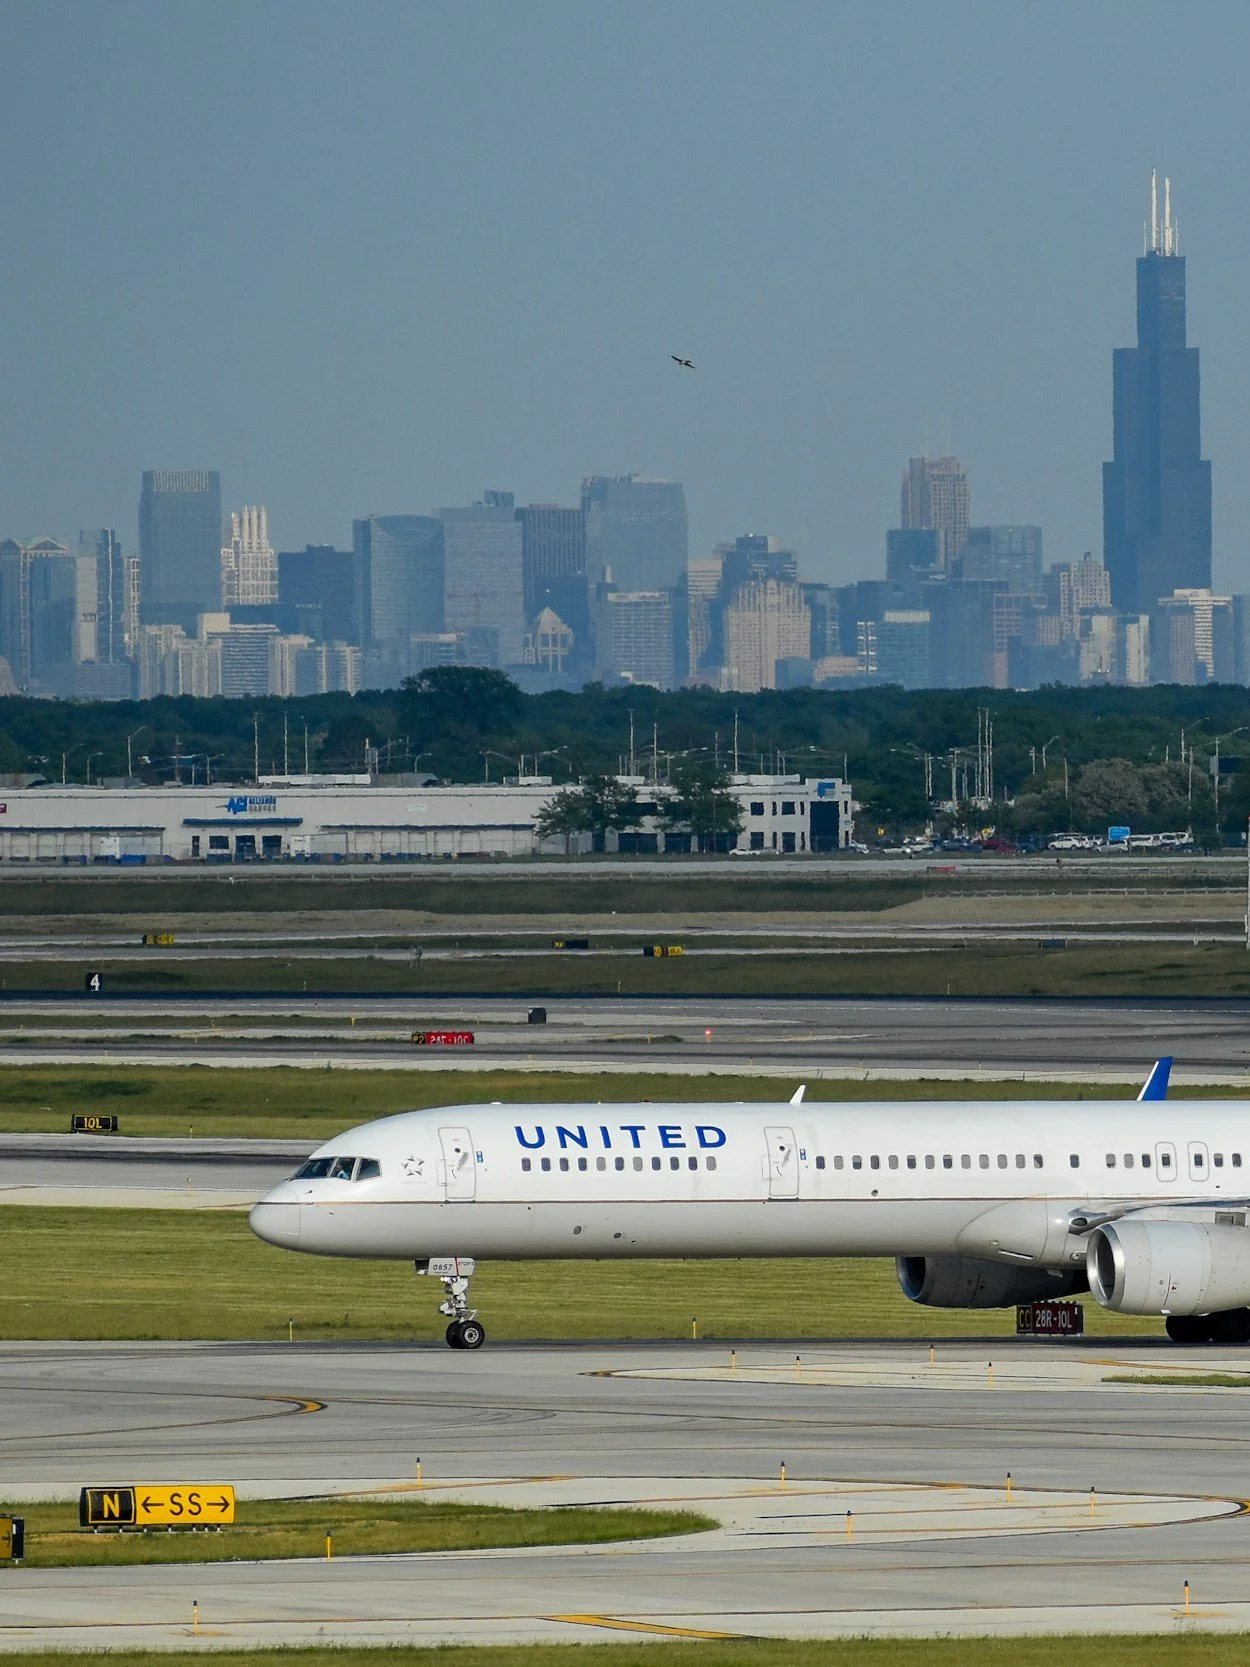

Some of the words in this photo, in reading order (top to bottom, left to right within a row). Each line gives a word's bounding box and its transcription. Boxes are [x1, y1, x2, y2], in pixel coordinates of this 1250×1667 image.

[90, 973, 100, 991] 4
[84, 1117, 103, 1129] 10L
[514, 1125, 727, 1149] UNITED
[432, 1263, 453, 1271] 0857
[1019, 1309, 1031, 1328] CC
[1035, 1309, 1073, 1329] 28R-10L
[103, 1491, 120, 1518] N
[169, 1492, 202, 1516] SS
